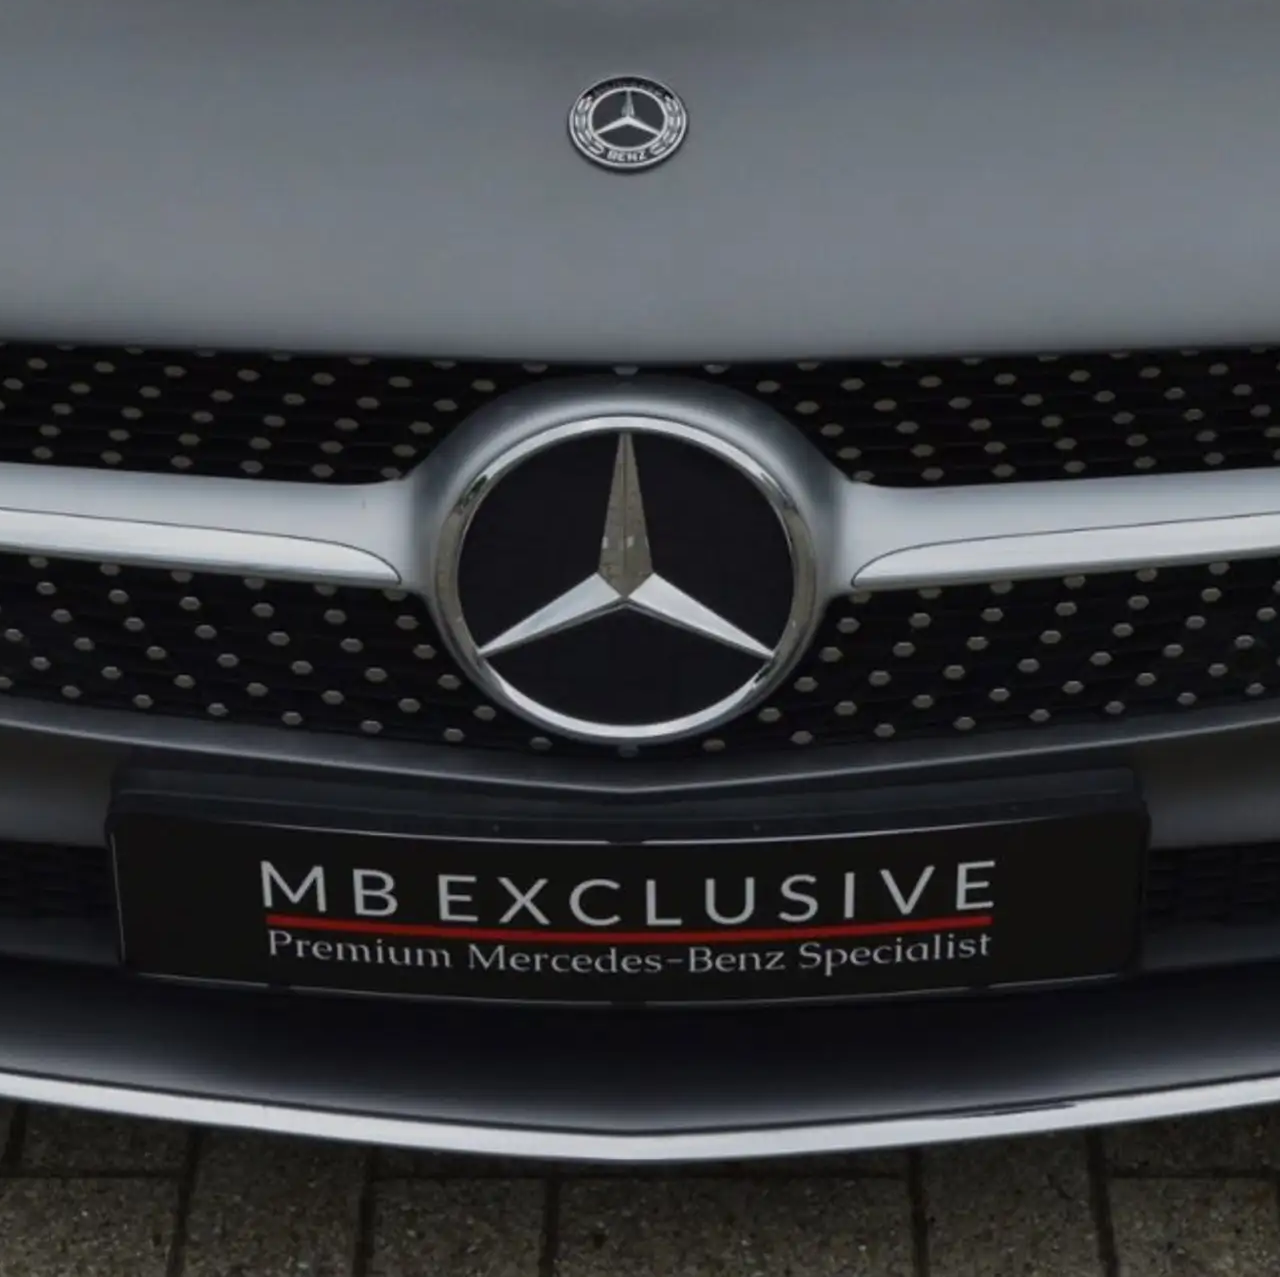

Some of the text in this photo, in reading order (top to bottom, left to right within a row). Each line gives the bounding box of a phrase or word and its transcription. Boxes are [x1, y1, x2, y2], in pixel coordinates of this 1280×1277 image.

[261, 860, 996, 926] MB EXCLUSIVE
[267, 930, 991, 977] Premium Mercedes-Benz Specialist
